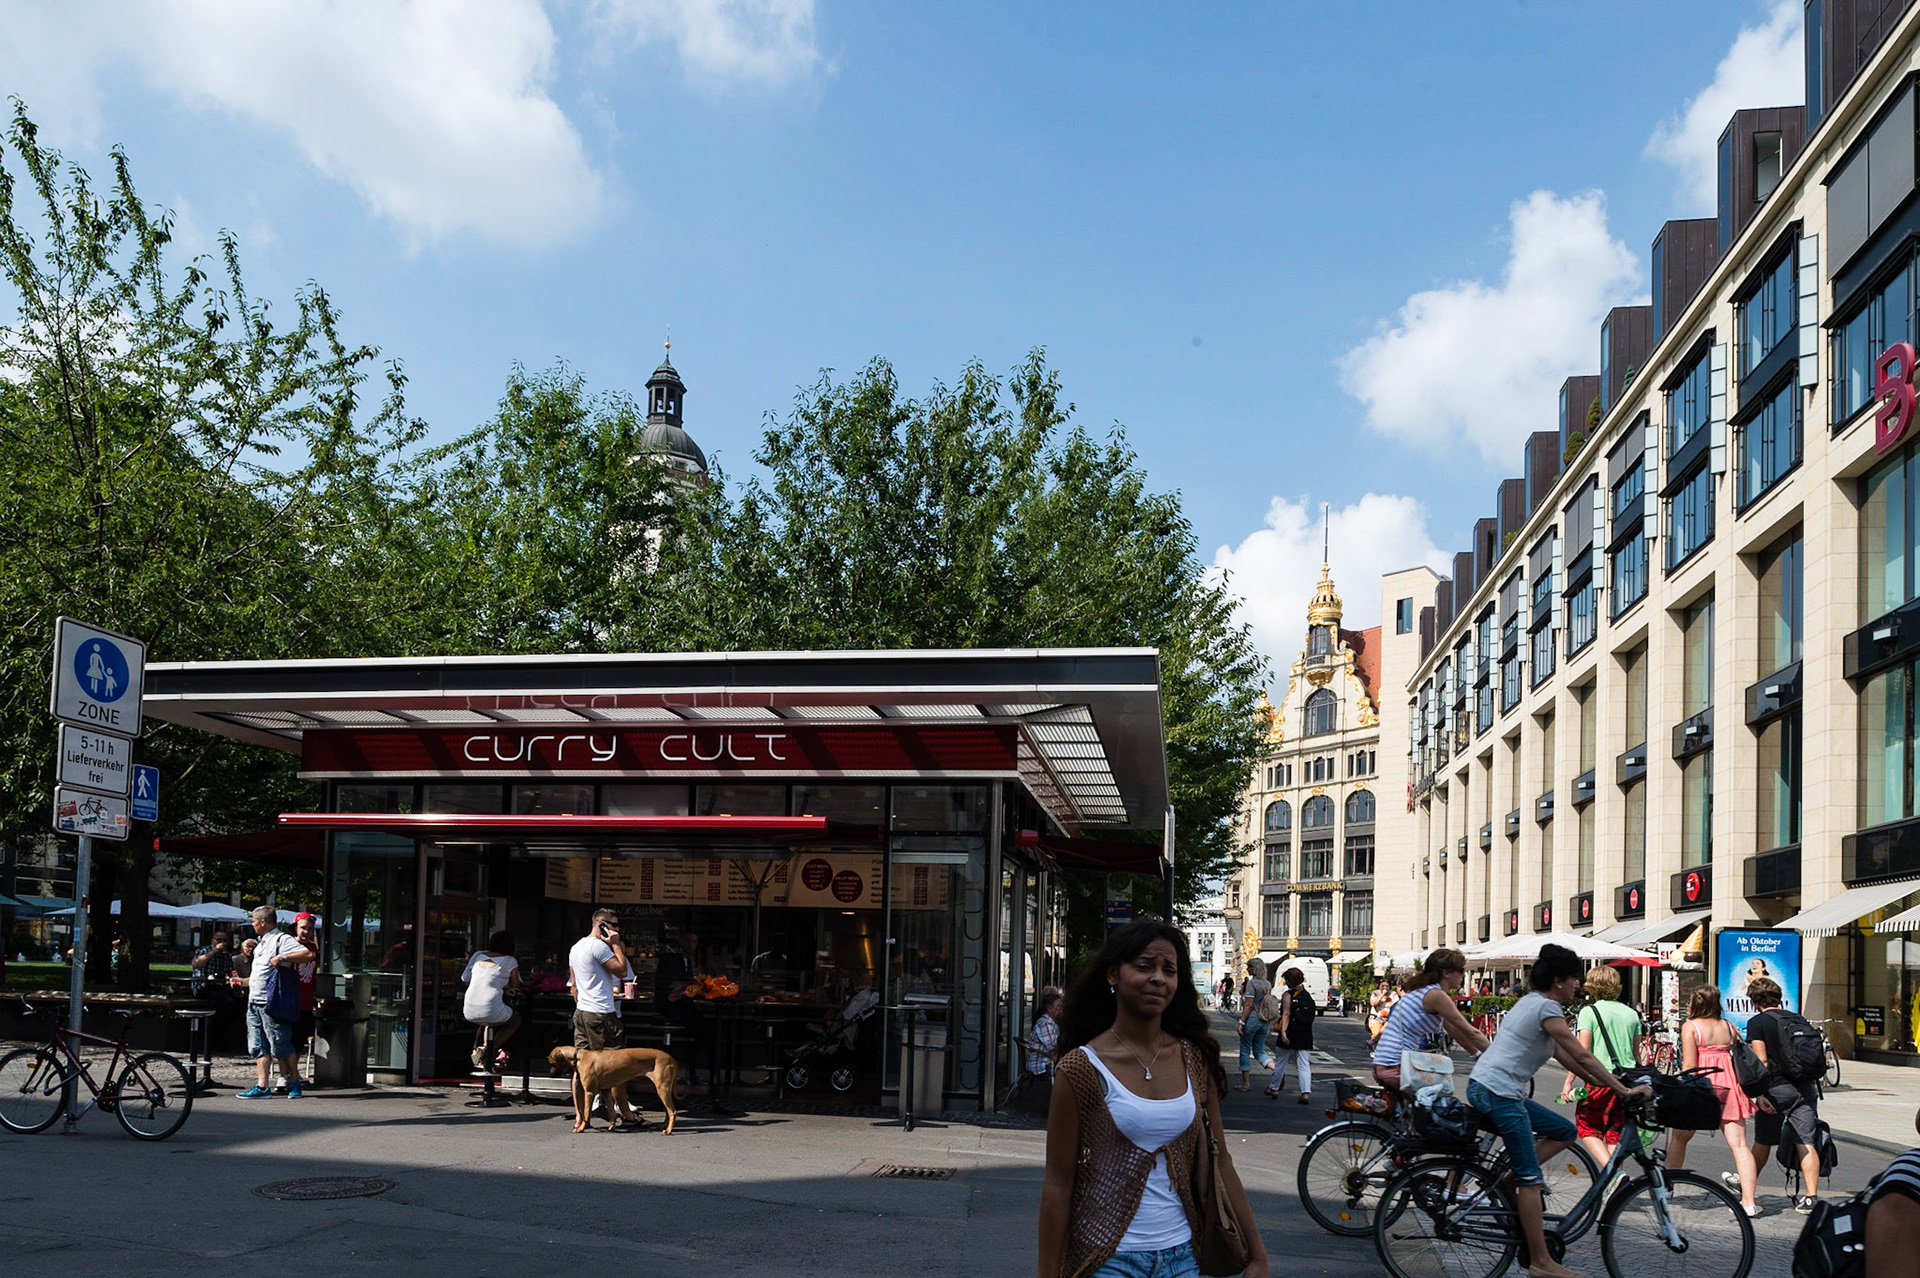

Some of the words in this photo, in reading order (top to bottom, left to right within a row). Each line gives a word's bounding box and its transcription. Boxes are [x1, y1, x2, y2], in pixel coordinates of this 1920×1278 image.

[78, 701, 120, 725] ZONE
[81, 736, 105, 753] 5-11
[108, 742, 114, 755] h
[67, 750, 125, 773] Lieferverkehr
[88, 771, 104, 784] frei
[1285, 882, 1343, 892] COMMERZBANK
[1750, 937, 1781, 945] Oktober
